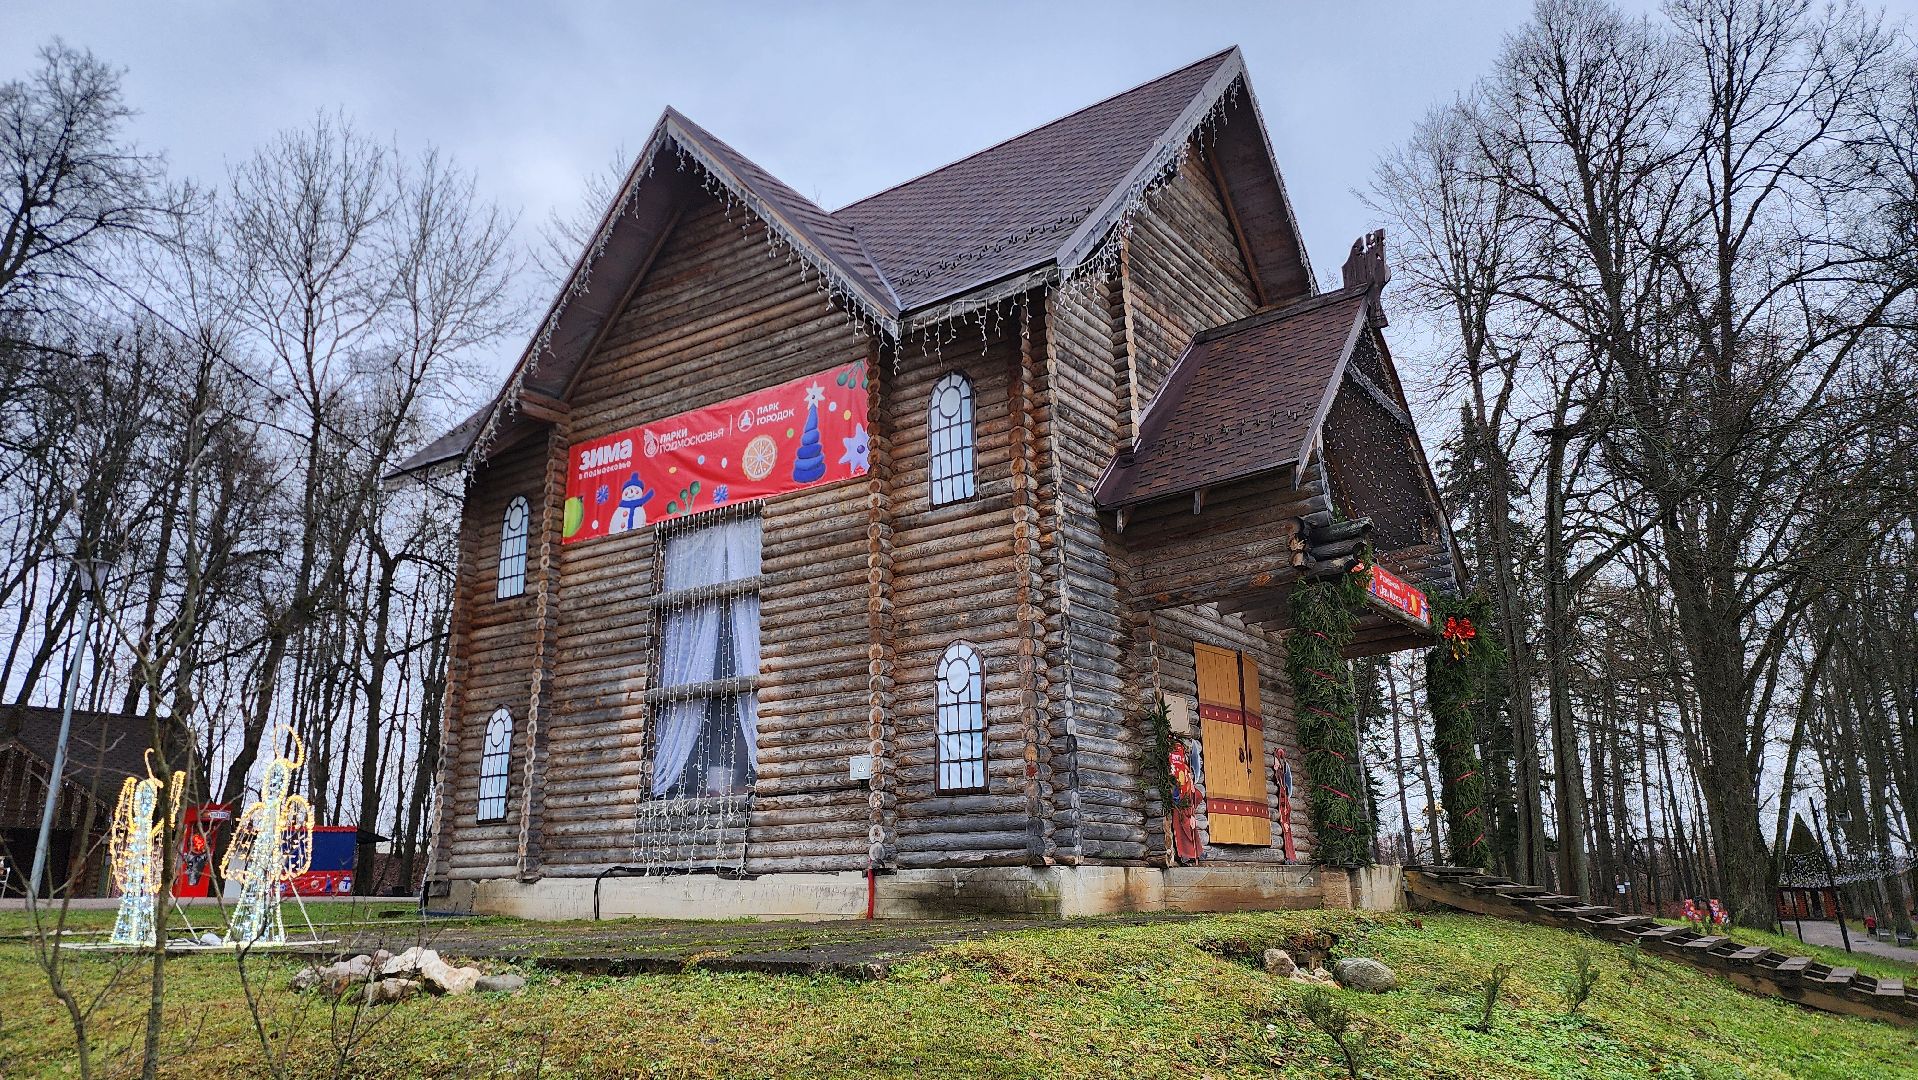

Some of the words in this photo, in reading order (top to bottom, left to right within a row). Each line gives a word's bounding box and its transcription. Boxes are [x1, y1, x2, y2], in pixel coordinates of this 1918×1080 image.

[756, 408, 795, 426] ГОРОДОК
[757, 402, 779, 415] ПАРК
[659, 428, 724, 454] ПОДМОСКОВЬЯ
[660, 428, 688, 444] ПАРКИ
